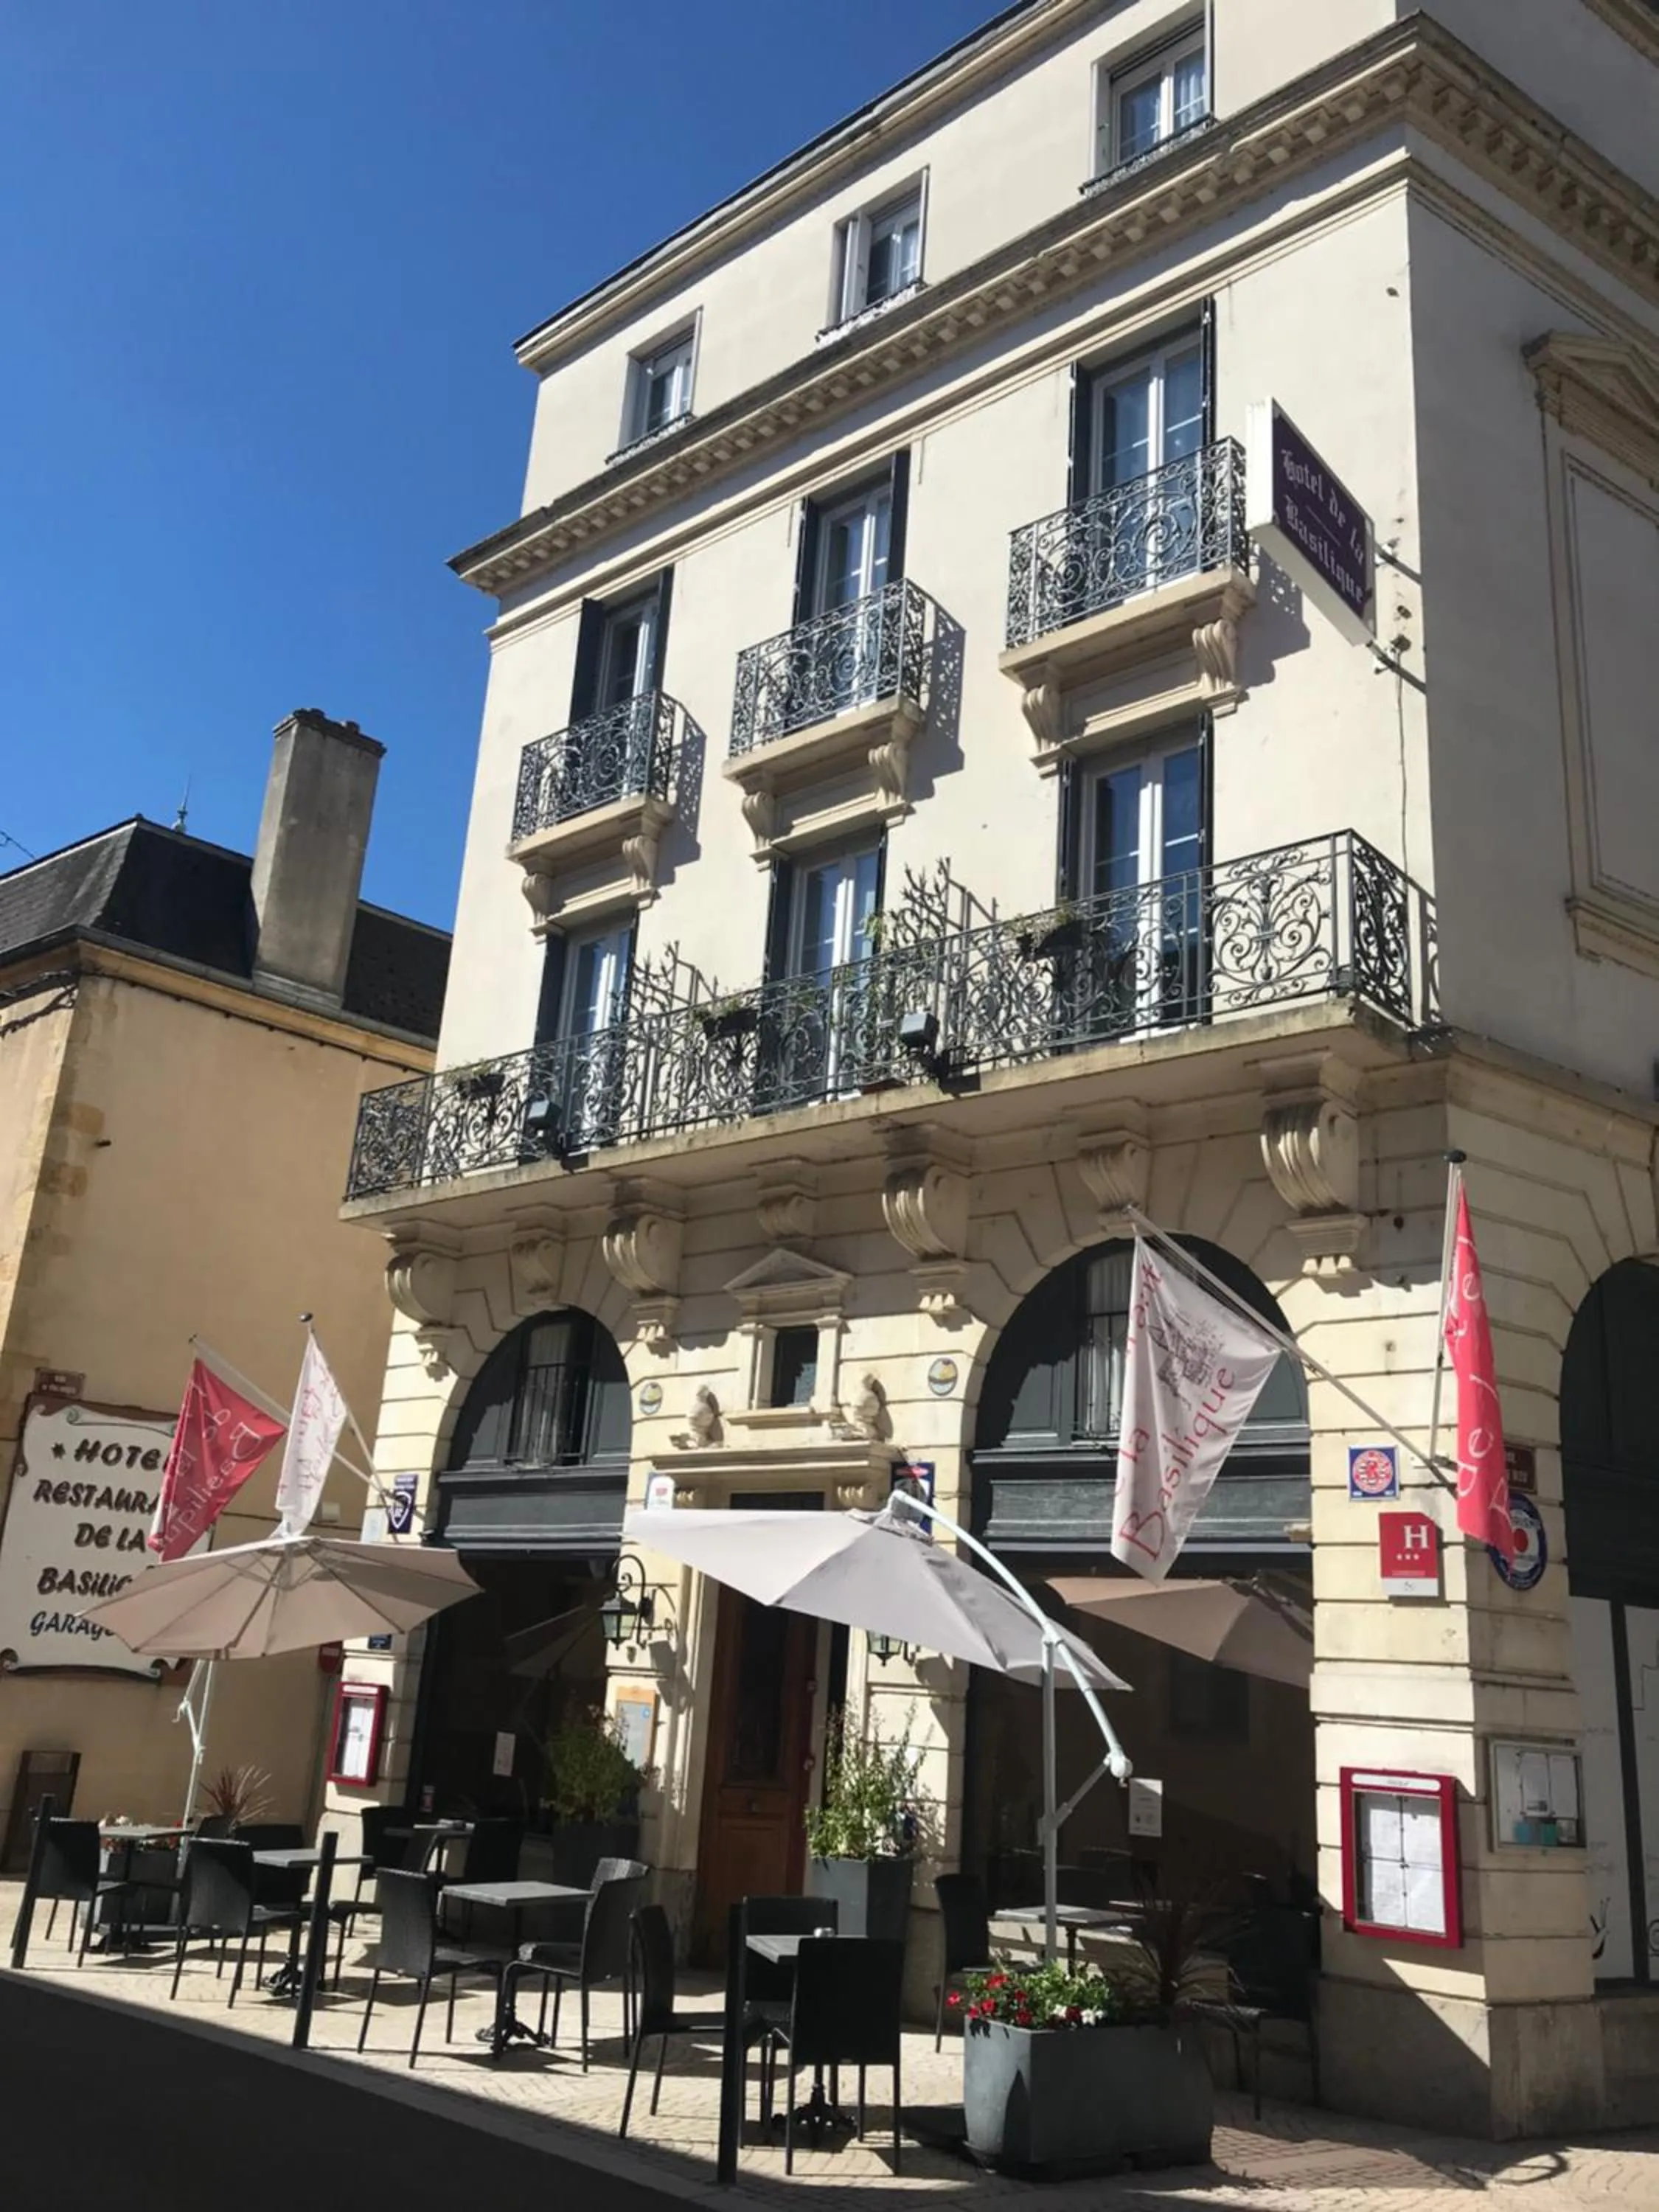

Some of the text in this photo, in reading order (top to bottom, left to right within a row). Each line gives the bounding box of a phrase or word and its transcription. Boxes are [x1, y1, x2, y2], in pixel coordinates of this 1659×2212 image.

[1284, 494, 1363, 603] Basilique
[1329, 487, 1346, 528] de
[1349, 527, 1364, 566] la
[1119, 1366, 1235, 1562] Basilique
[33, 1479, 160, 1515] RESTAUR
[74, 1523, 146, 1553] DE LA
[1404, 1525, 1430, 1549] H
